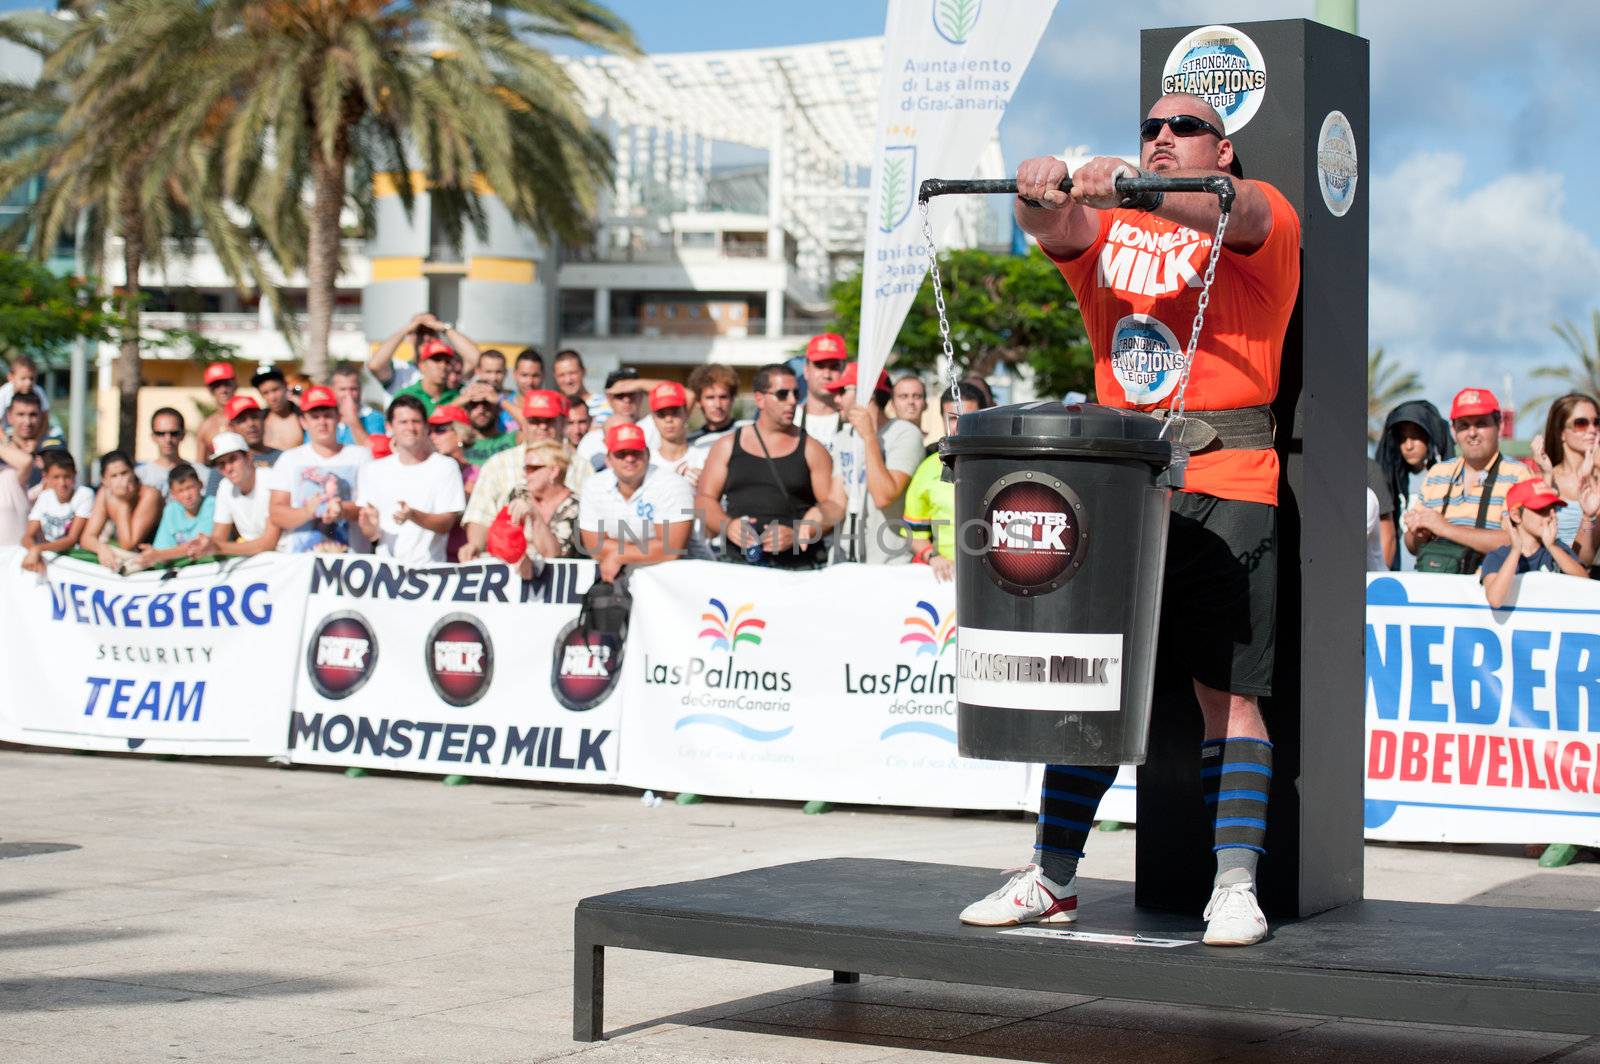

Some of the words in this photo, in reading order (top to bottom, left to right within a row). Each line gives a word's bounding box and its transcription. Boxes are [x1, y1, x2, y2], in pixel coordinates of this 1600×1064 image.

[1182, 55, 1246, 72] STRONGMAN
[956, 74, 1010, 92] almas
[1163, 69, 1266, 95] CHAMPIONS
[1097, 241, 1205, 297] MILK
[992, 510, 1067, 526] MONSTER
[992, 523, 1067, 550] MILK
[310, 557, 511, 602] MONSTER
[519, 563, 600, 604] MIL
[50, 582, 273, 628] VENEBERG
[96, 644, 214, 664] SECURITY
[959, 649, 1046, 683] MONSTER
[1050, 656, 1109, 684] MILK
[644, 655, 792, 693] LasPalmas
[83, 676, 207, 723] TEAM
[889, 699, 957, 715] deGranC
[291, 711, 496, 764] MONSTER
[501, 726, 612, 771] MILK
